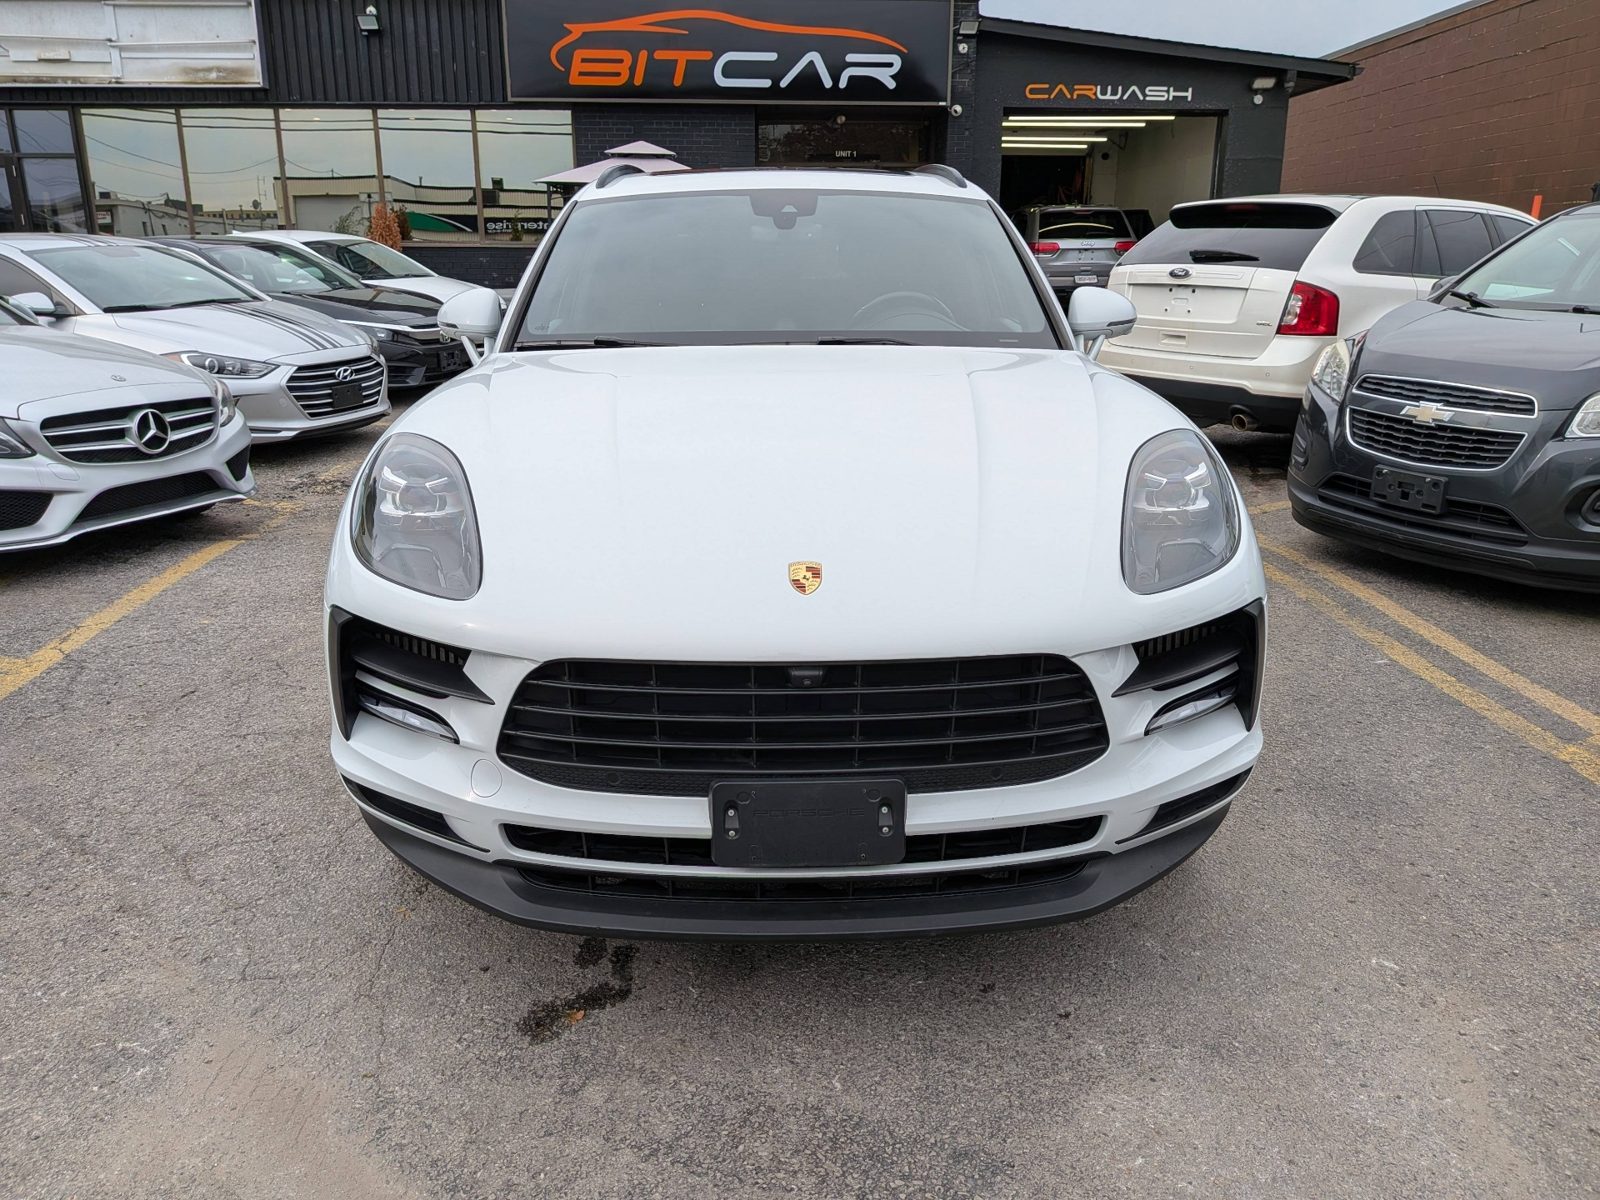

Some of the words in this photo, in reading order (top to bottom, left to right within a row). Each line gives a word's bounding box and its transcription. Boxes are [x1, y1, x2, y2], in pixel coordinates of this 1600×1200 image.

[568, 49, 902, 90] BITCAR
[1025, 83, 1193, 102] CARWASH
[835, 150, 852, 158] UNIT
[752, 807, 865, 818] PORSCHE
